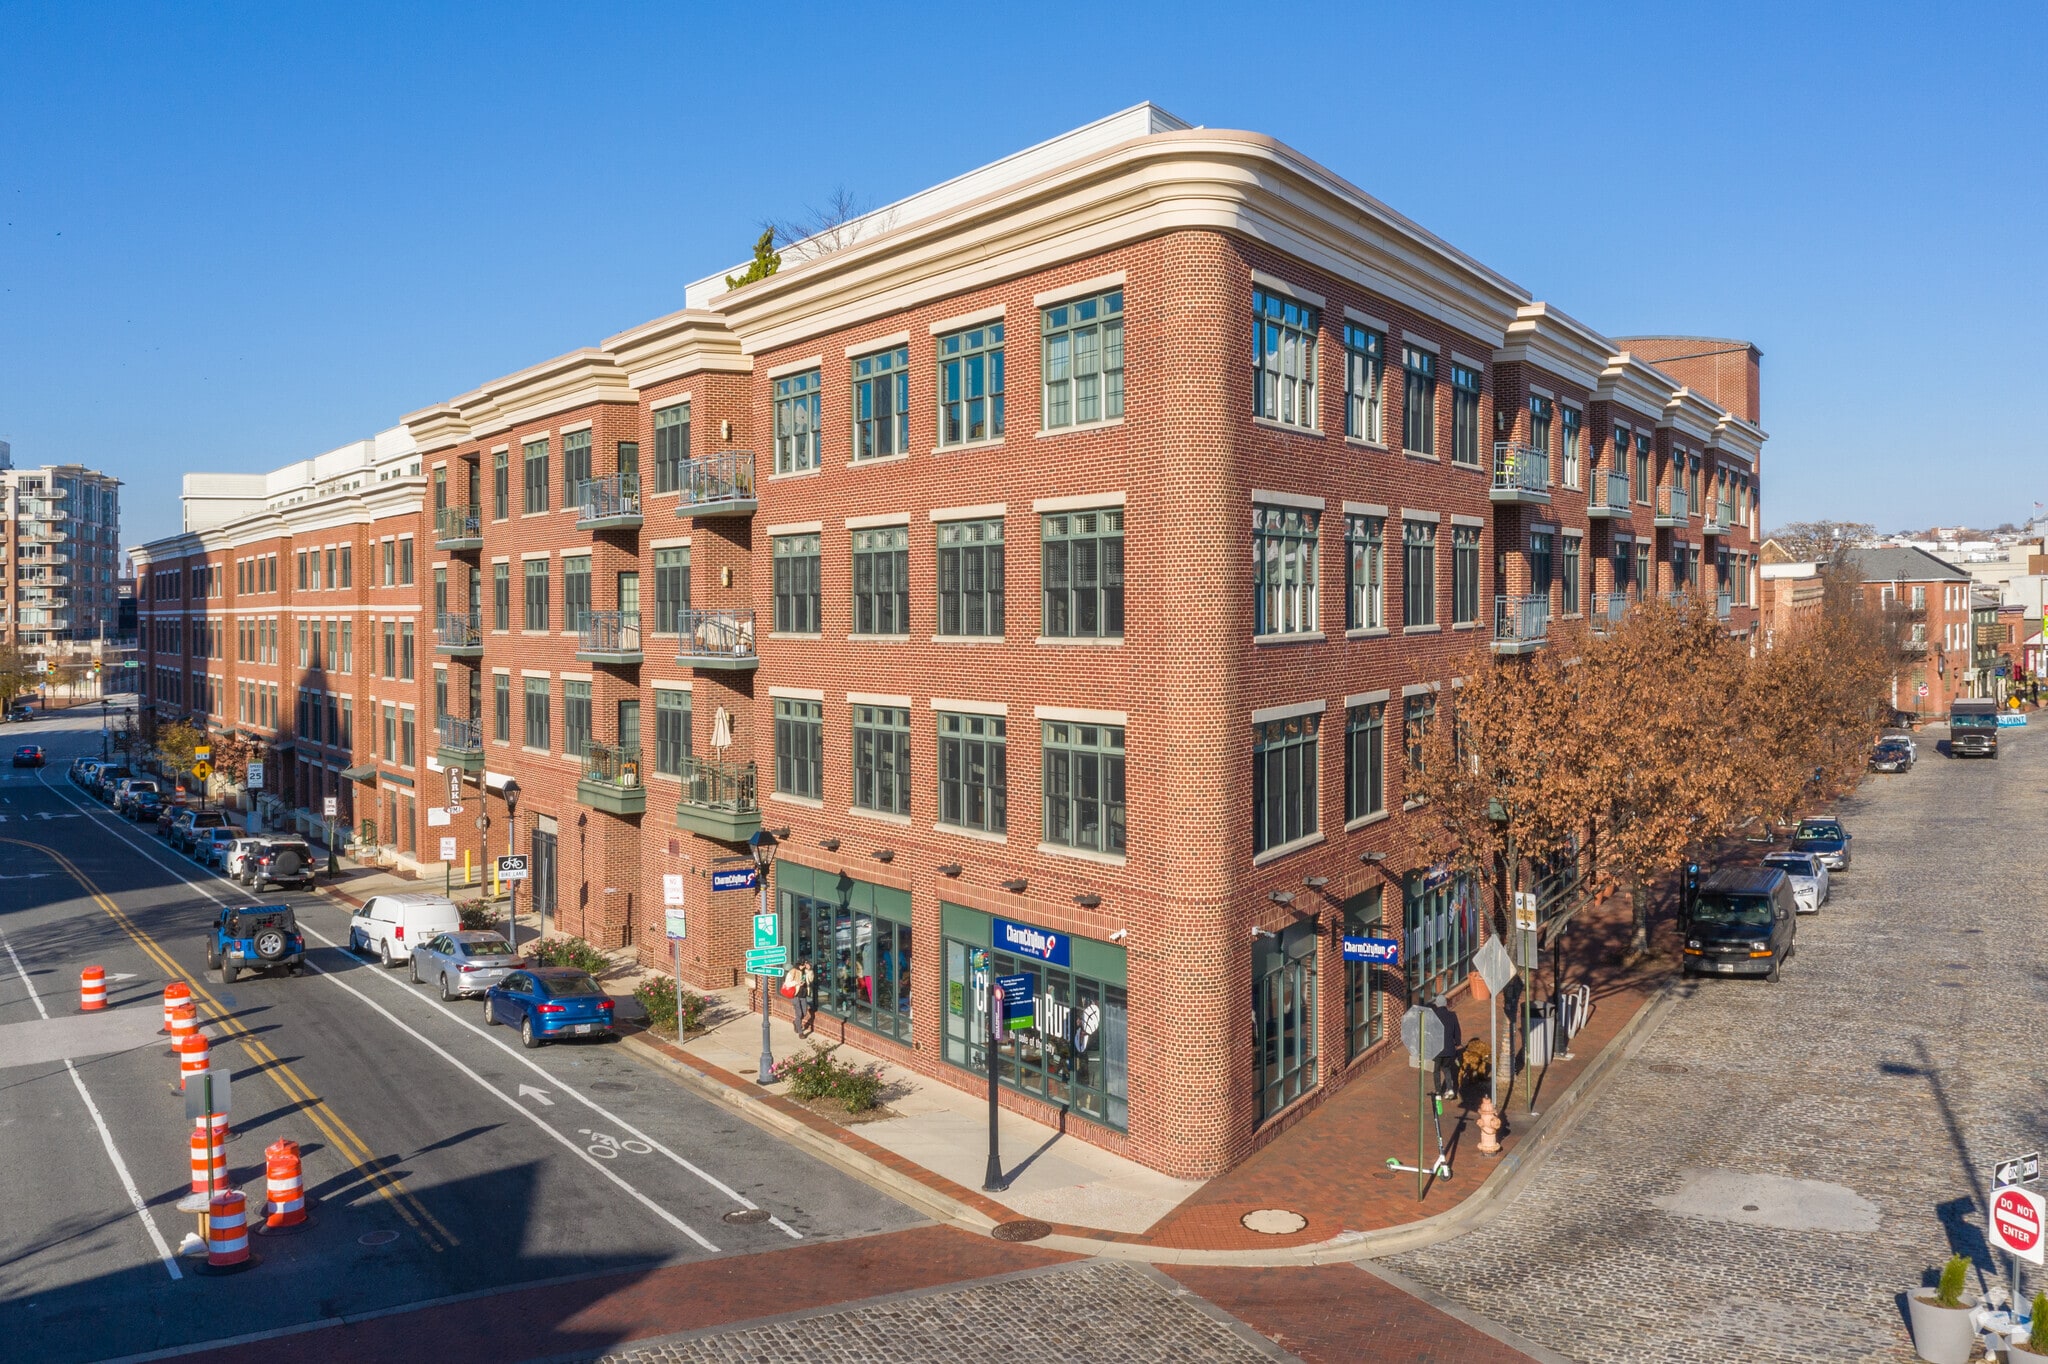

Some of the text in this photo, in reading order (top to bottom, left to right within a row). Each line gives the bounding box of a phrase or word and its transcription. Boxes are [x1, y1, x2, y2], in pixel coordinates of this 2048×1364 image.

[451, 768, 459, 799] PARK
[1006, 925, 1046, 951] CharmCityRun
[1344, 941, 1386, 956] CharmCityRun
[2000, 1197, 2034, 1219] DO NOT
[2003, 1223, 2030, 1243] ENTER
